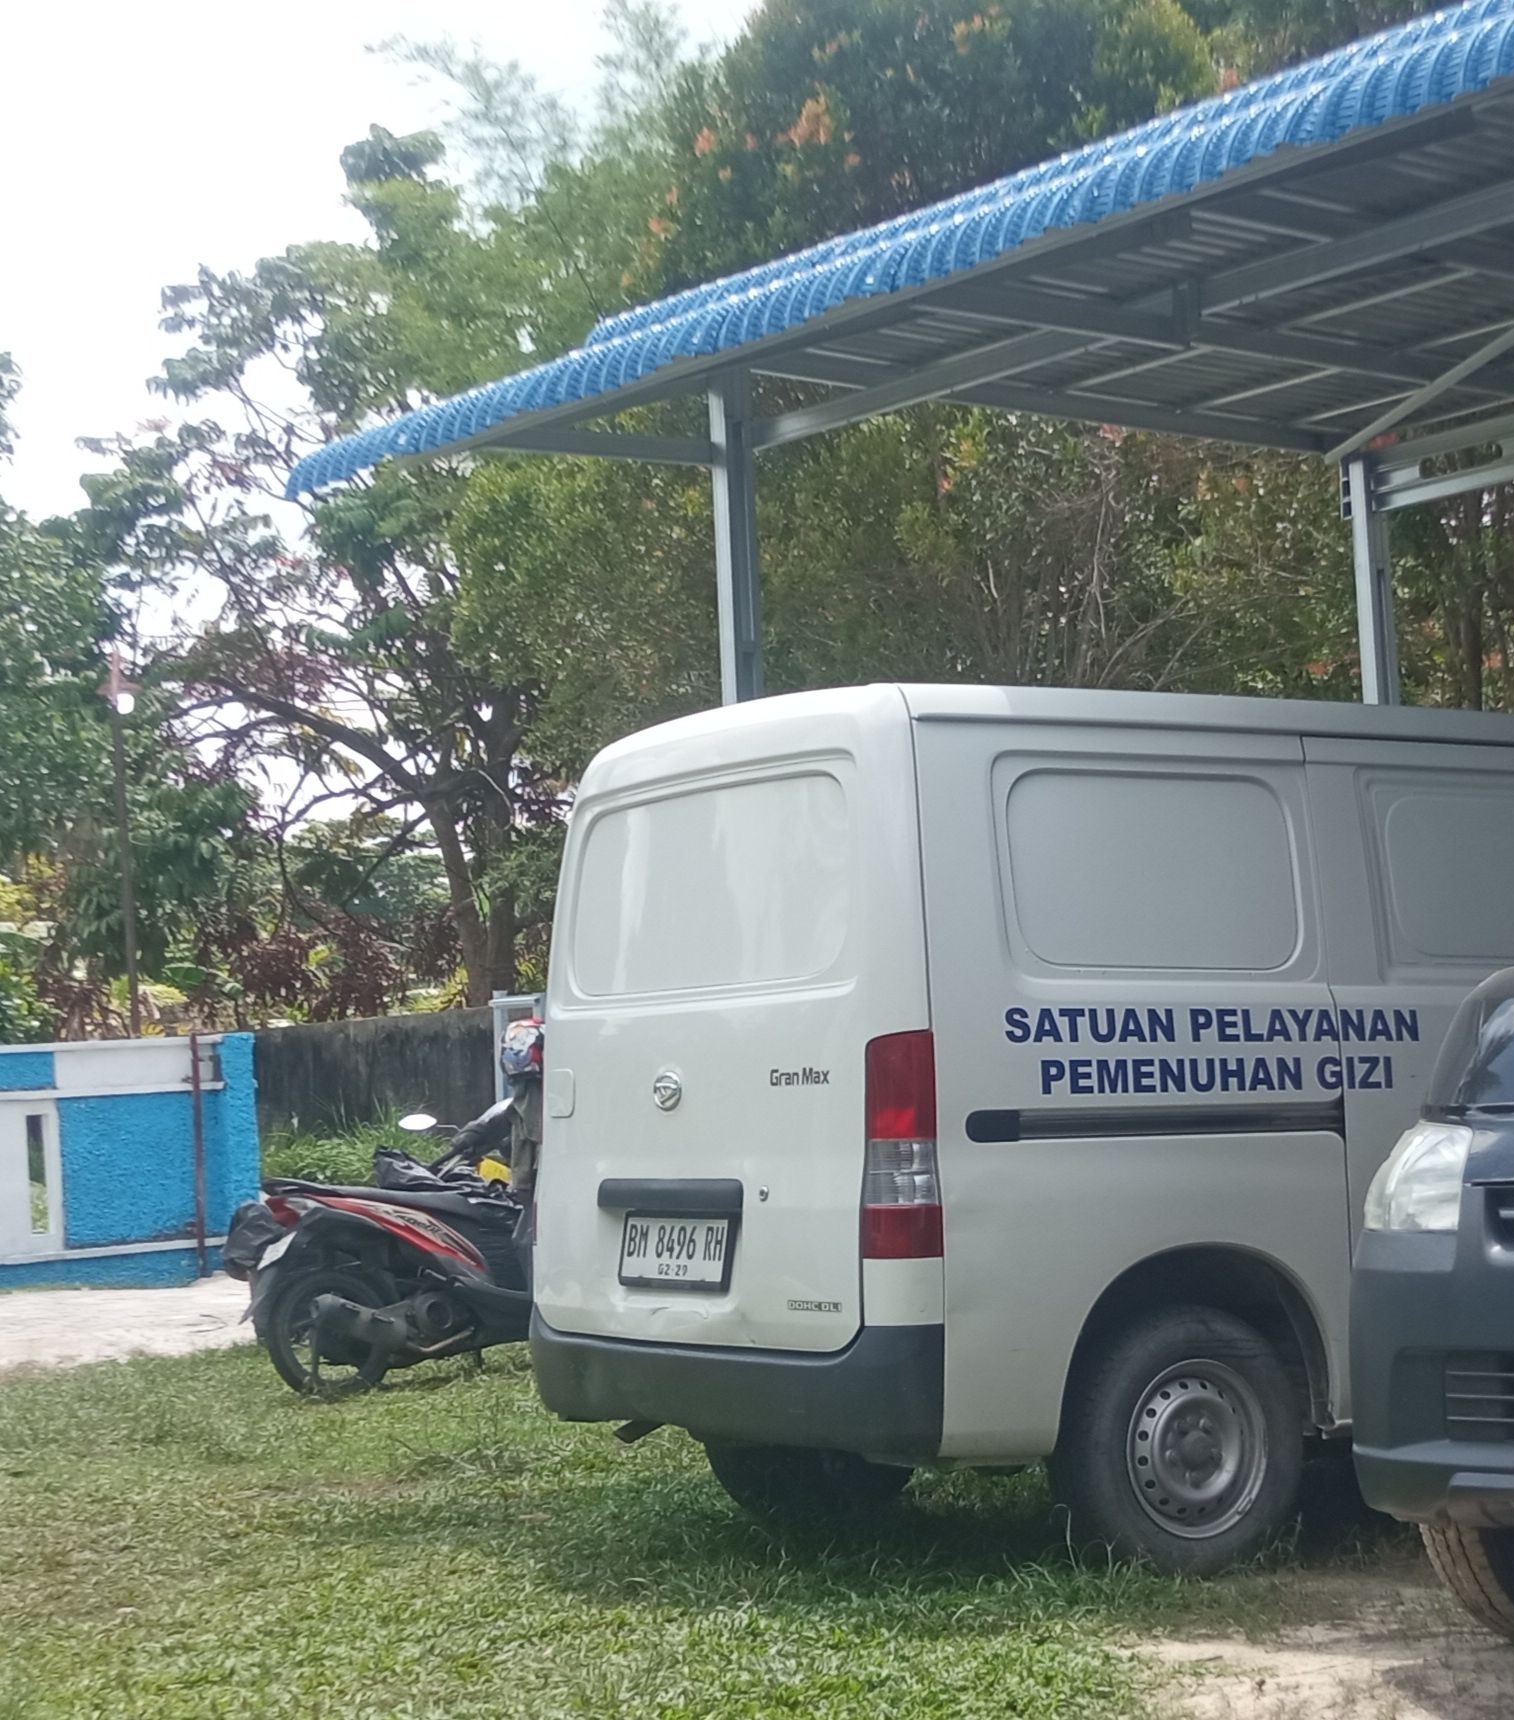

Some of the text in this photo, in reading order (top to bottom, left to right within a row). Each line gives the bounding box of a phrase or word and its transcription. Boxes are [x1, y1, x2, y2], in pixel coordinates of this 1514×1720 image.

[1004, 1007, 1420, 1043] SATUAN PELAYANAN
[770, 1067, 830, 1086] Gran Max
[1040, 1056, 1393, 1095] PEMENUHAN GIZI
[626, 1223, 725, 1261] BM 8496 RH
